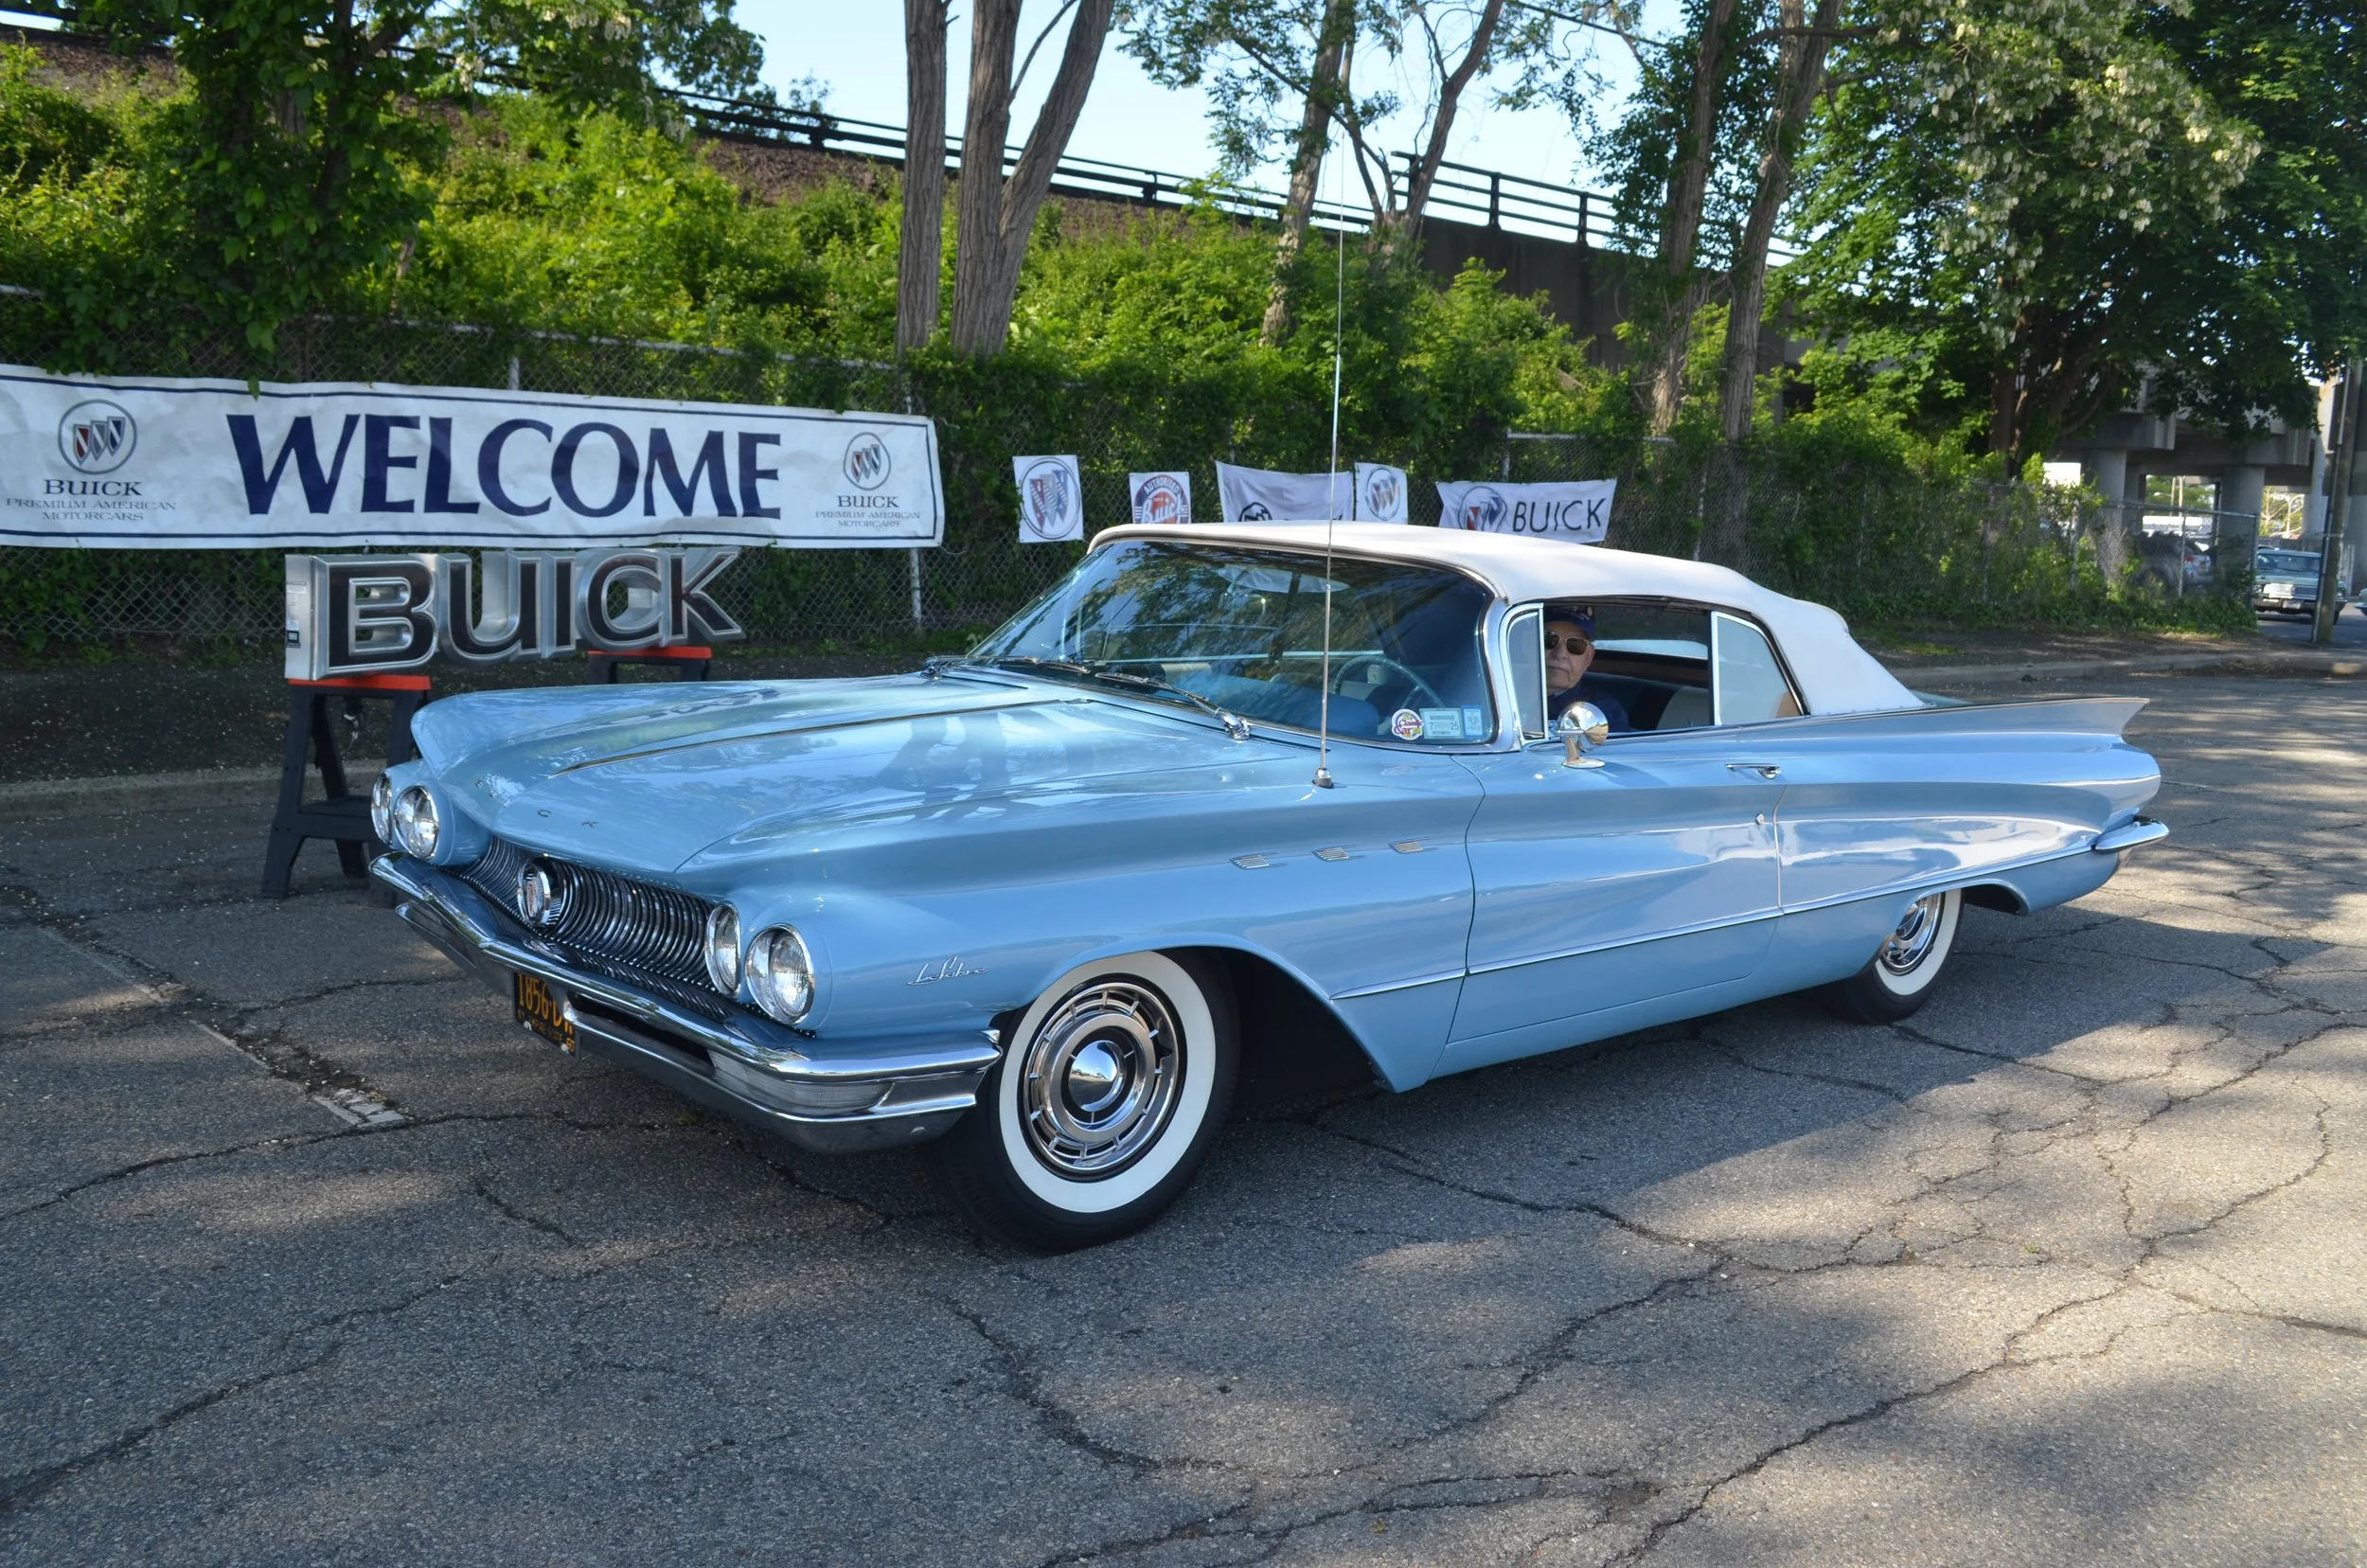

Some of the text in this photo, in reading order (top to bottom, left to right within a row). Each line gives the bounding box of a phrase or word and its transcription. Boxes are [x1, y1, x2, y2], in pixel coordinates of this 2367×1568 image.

[226, 414, 781, 520] WELCOME
[44, 479, 142, 496] BUICK
[1143, 476, 1181, 494] AUTHORIZED
[7, 498, 176, 510] PREMIUM AMERICAN
[837, 495, 899, 508] BUICK
[1140, 493, 1184, 524] Buick
[43, 511, 144, 521] MOTORCARS
[1512, 498, 1606, 532] BUICK
[325, 549, 744, 672] BUICK
